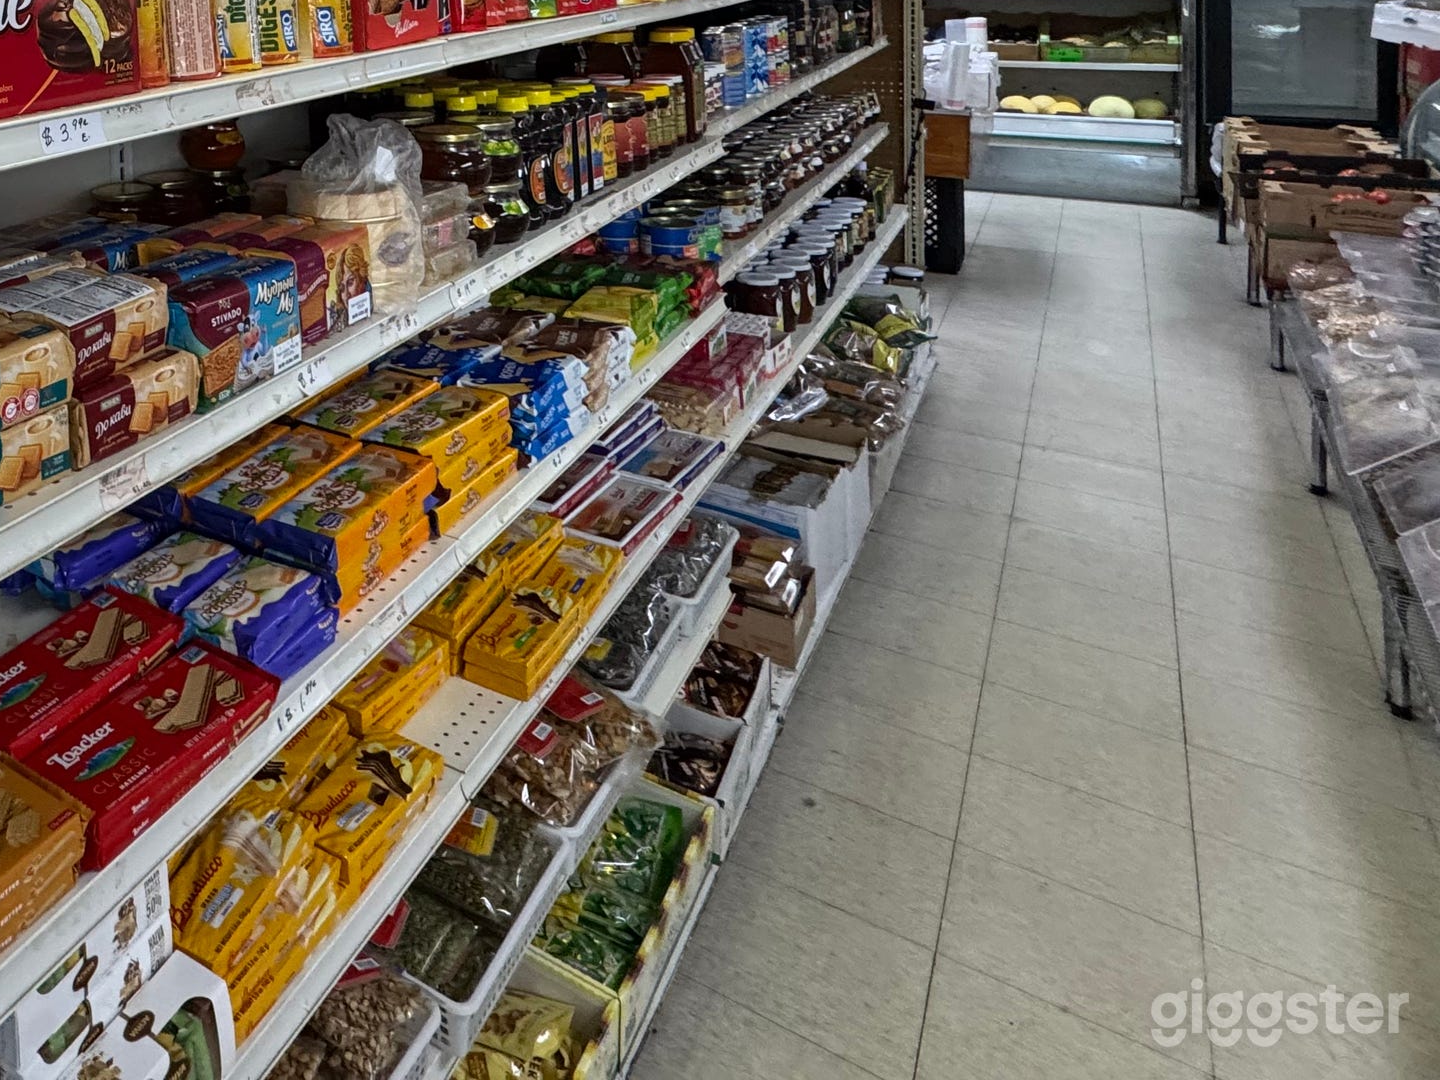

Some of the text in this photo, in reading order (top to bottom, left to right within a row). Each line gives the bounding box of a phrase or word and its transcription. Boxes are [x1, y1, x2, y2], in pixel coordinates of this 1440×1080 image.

[282, 12, 296, 48] SIRO
[317, 9, 338, 44] SIRO
[104, 59, 133, 74] 12 PACKS
[254, 271, 295, 306] Мудрый
[277, 295, 295, 316] Му
[211, 306, 243, 328] STIVADO
[29, 697, 60, 720] HAZELNUT
[46, 721, 115, 771] Loacker
[92, 746, 157, 795] CLASSIC
[118, 764, 152, 791] HAZELNUT
[300, 779, 358, 832] Bauducco
[171, 855, 223, 933] Bauducco
